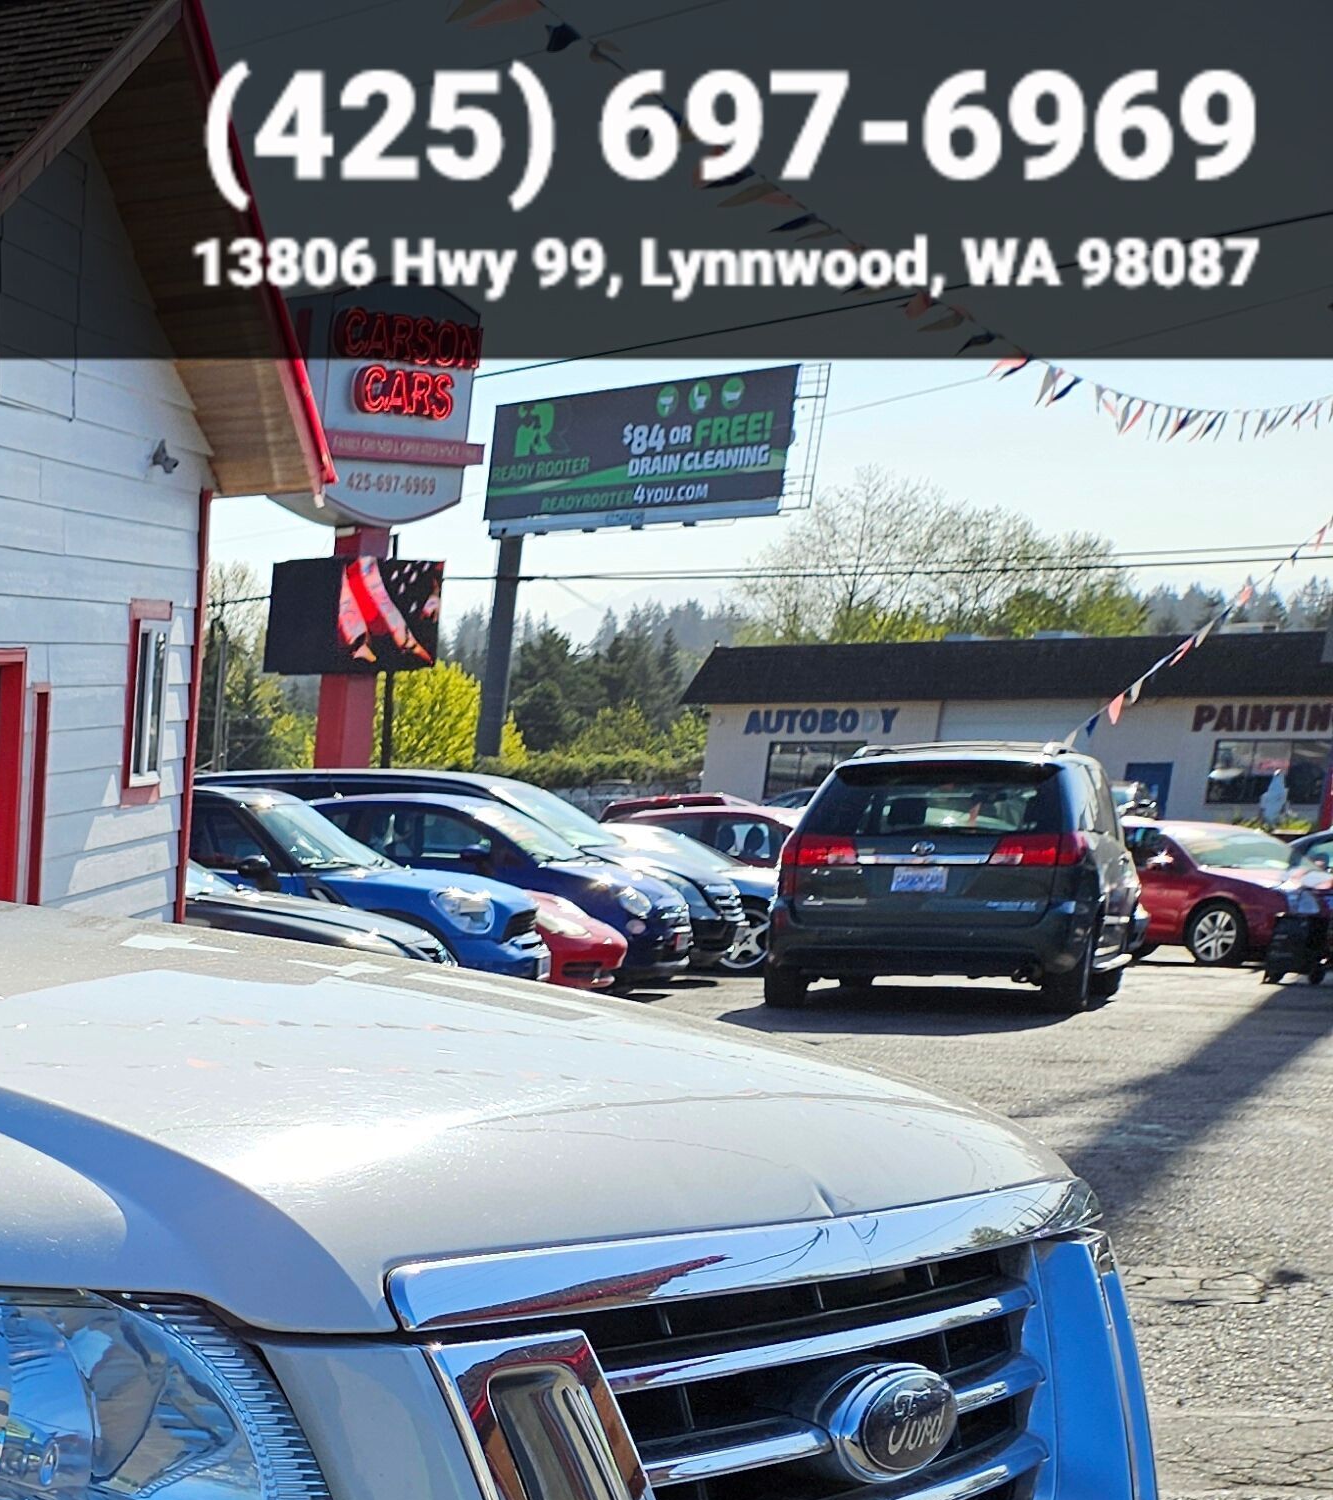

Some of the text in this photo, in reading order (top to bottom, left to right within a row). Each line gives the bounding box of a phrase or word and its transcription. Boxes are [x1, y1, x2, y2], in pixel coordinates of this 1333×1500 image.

[341, 306, 483, 369] CARSON
[360, 363, 455, 421] CARS
[623, 411, 774, 455] $84 OR FREE!
[491, 457, 590, 481] READY ROOTER
[627, 444, 771, 478] DRAIN CLEANING
[744, 708, 900, 735] AUTOBODY
[887, 1388, 946, 1456] Ford
